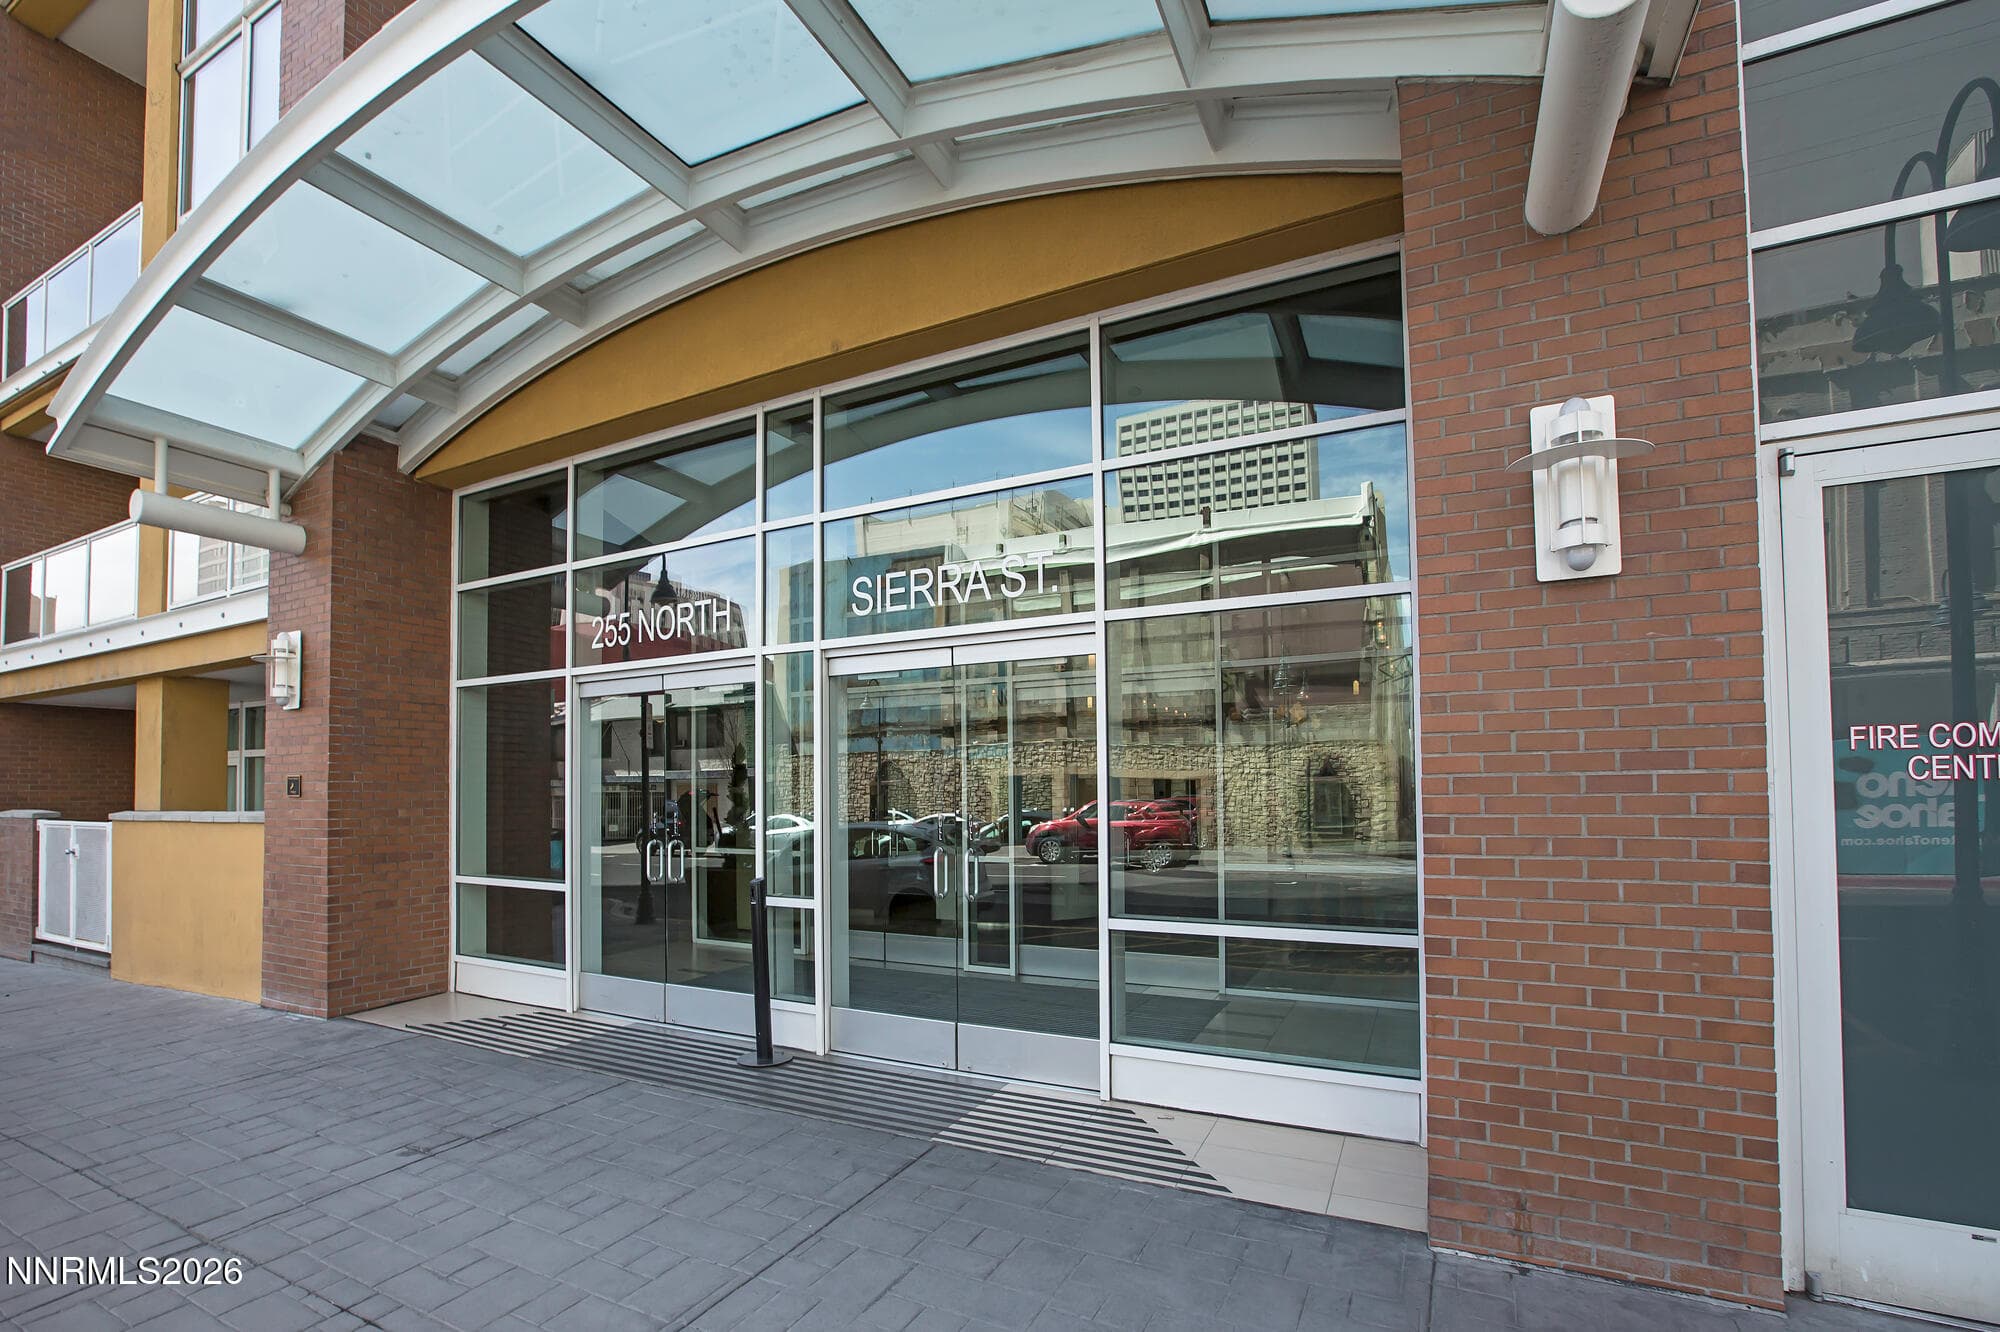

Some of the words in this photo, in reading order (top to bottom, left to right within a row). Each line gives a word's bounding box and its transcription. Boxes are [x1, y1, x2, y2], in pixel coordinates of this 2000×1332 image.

[851, 560, 992, 617] SIERRA
[1000, 551, 1058, 598] ST.
[592, 612, 631, 649] 255
[638, 597, 730, 643] NORTH
[1850, 723, 1920, 750] FIRE
[1907, 753, 2000, 780] CENT
